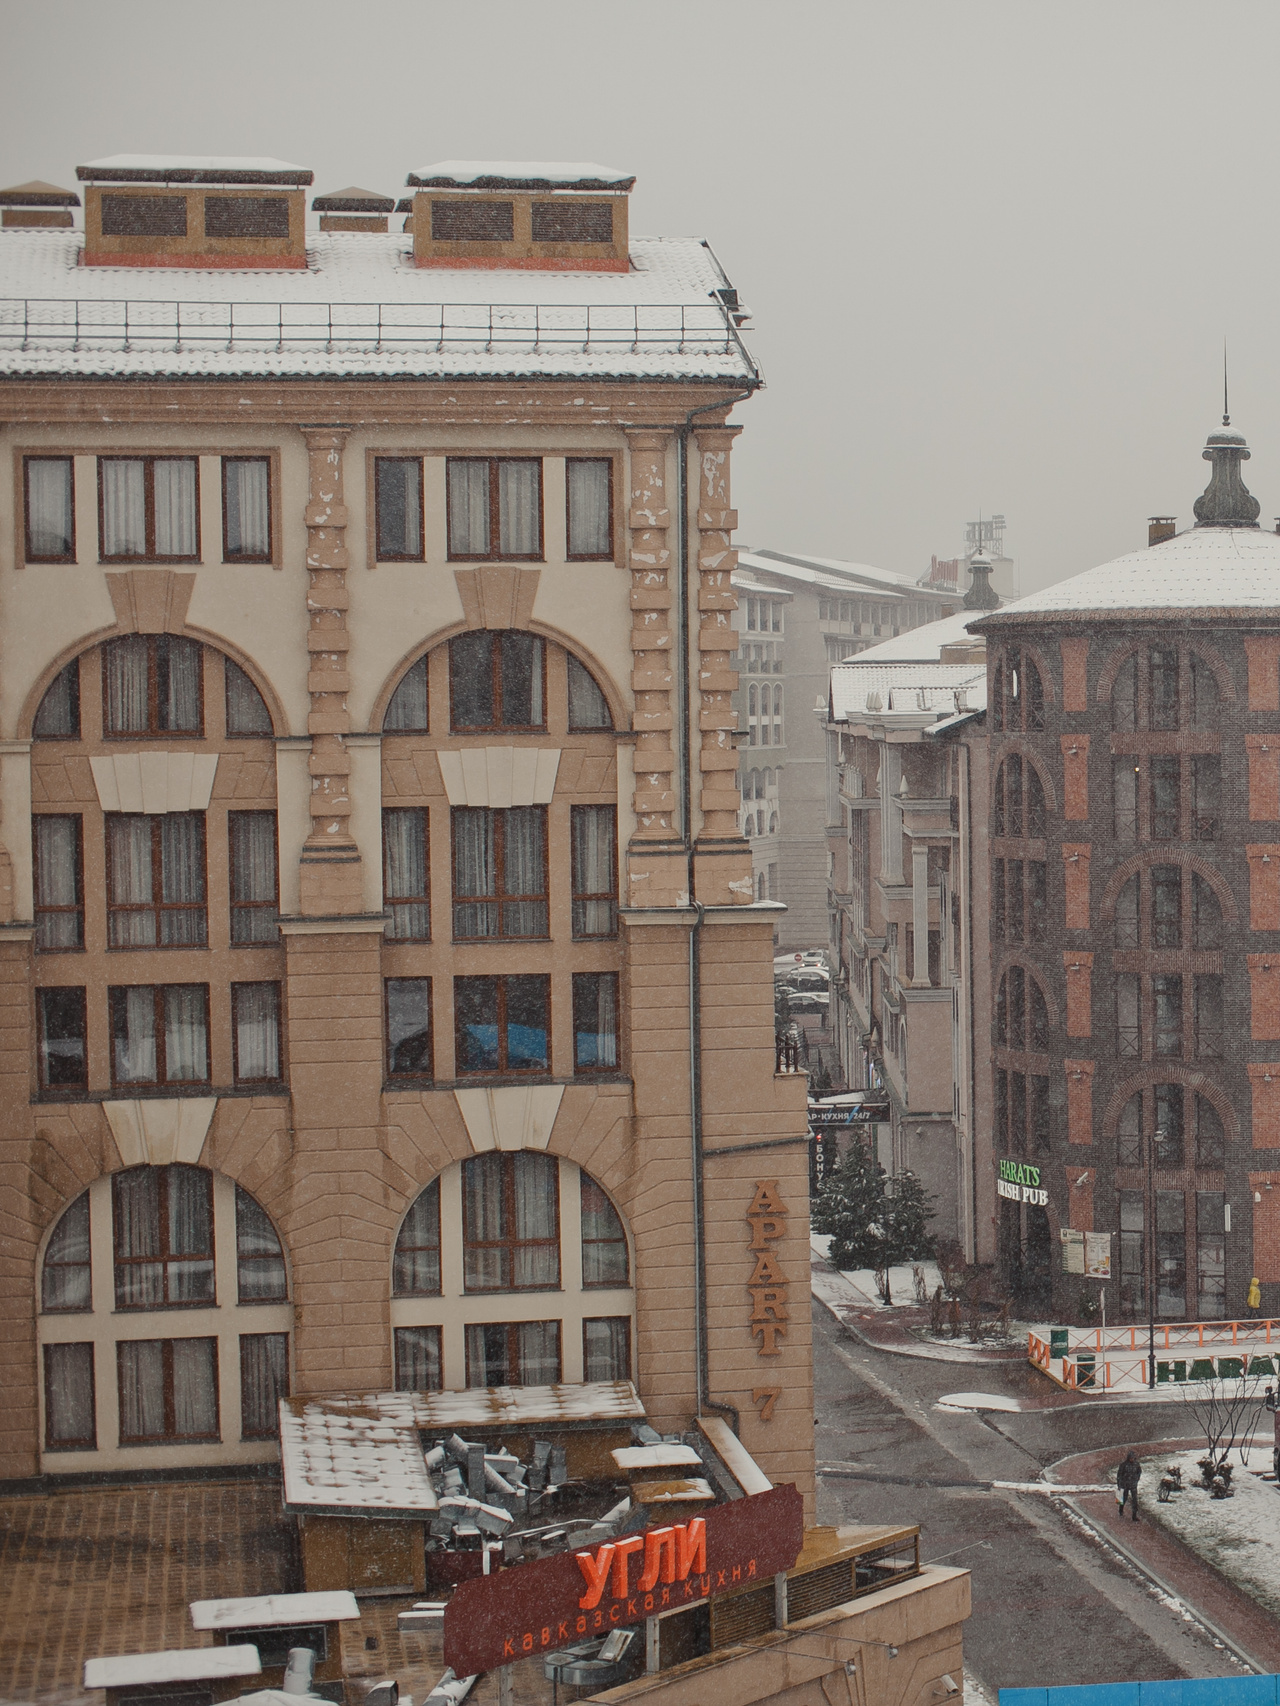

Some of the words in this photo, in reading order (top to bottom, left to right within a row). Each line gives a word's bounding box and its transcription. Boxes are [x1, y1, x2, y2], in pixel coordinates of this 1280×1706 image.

[853, 1111, 871, 1120] 24/7
[999, 1159, 1041, 1187] HARAT'S
[997, 1178, 1020, 1201] IRISH
[1022, 1185, 1049, 1207] PUB
[746, 1180, 789, 1356] APART
[753, 1387, 782, 1420] 7
[575, 1517, 707, 1610] УГЛИ
[503, 1589, 671, 1657] кавказская
[684, 1558, 758, 1597] кухня
